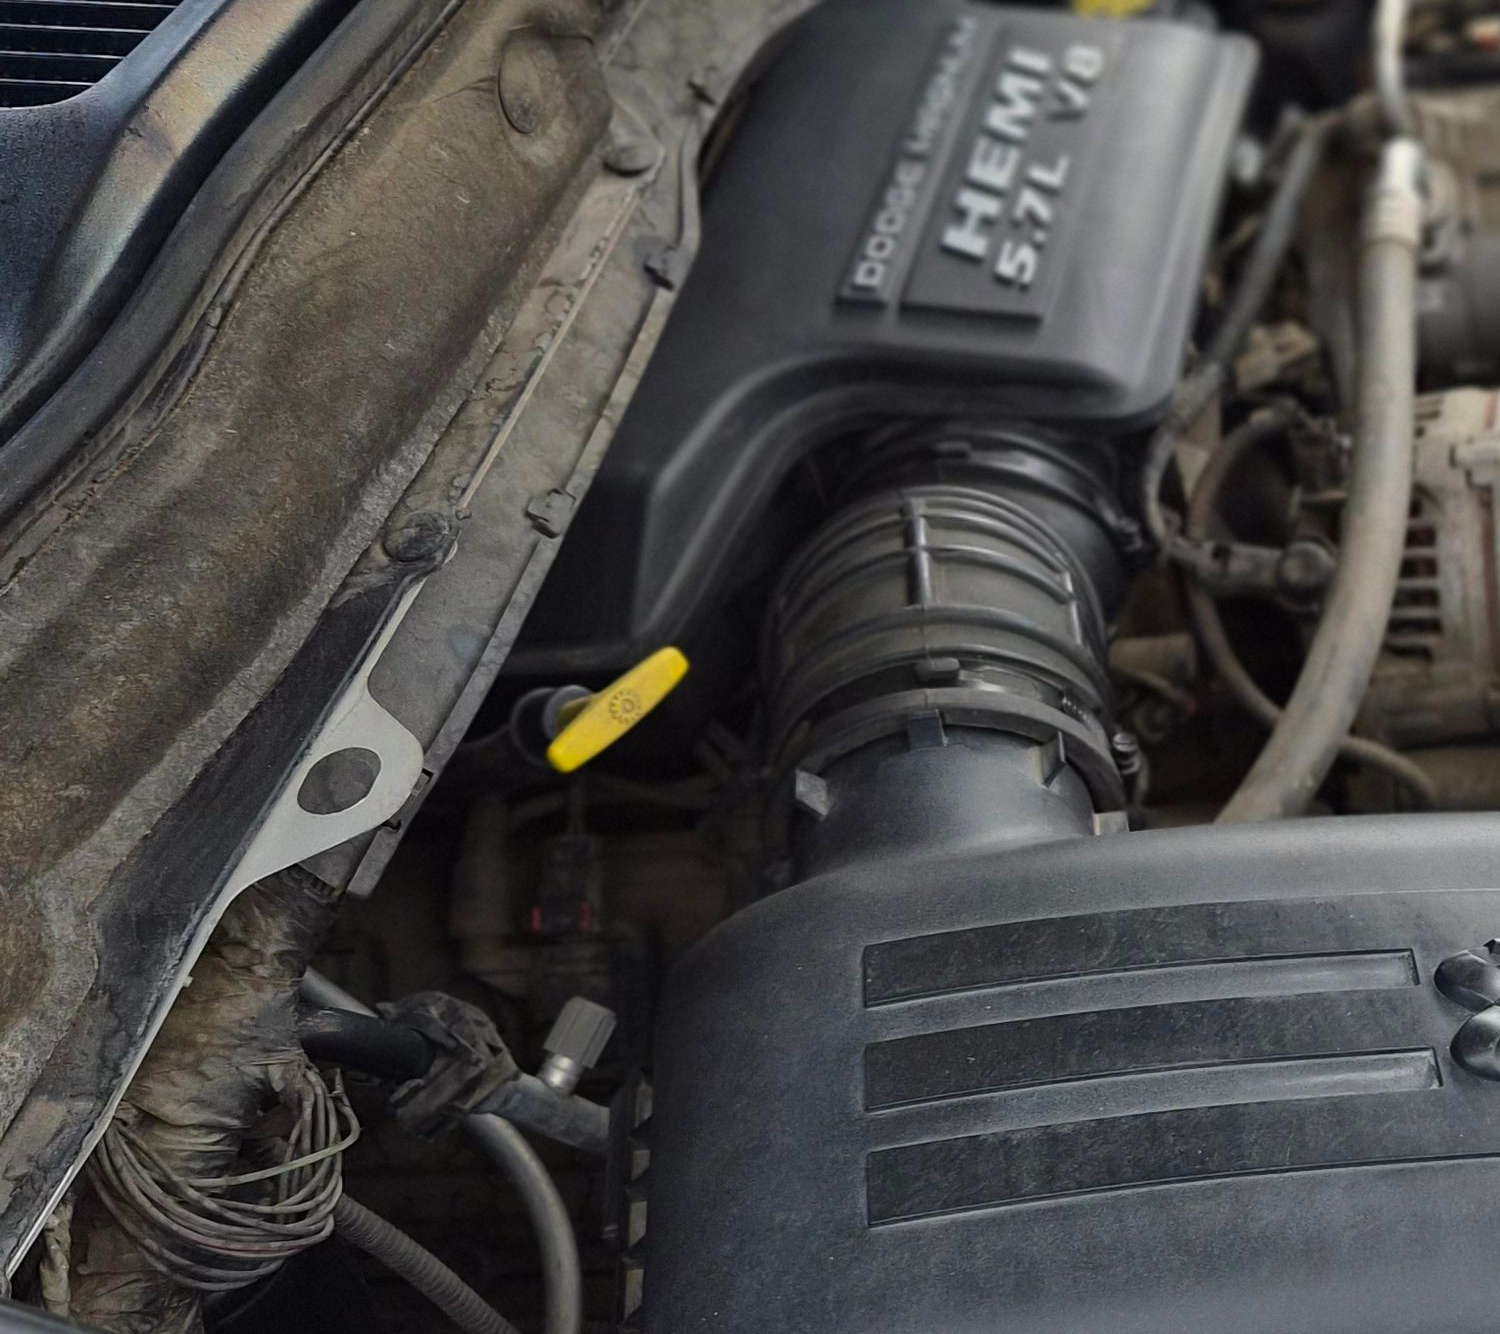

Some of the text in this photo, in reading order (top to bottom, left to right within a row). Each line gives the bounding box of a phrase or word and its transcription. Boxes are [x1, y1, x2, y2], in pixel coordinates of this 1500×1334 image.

[853, 157, 926, 288] DODGE
[941, 48, 1052, 262] HEMI
[995, 43, 1106, 291] 5.7L V8
